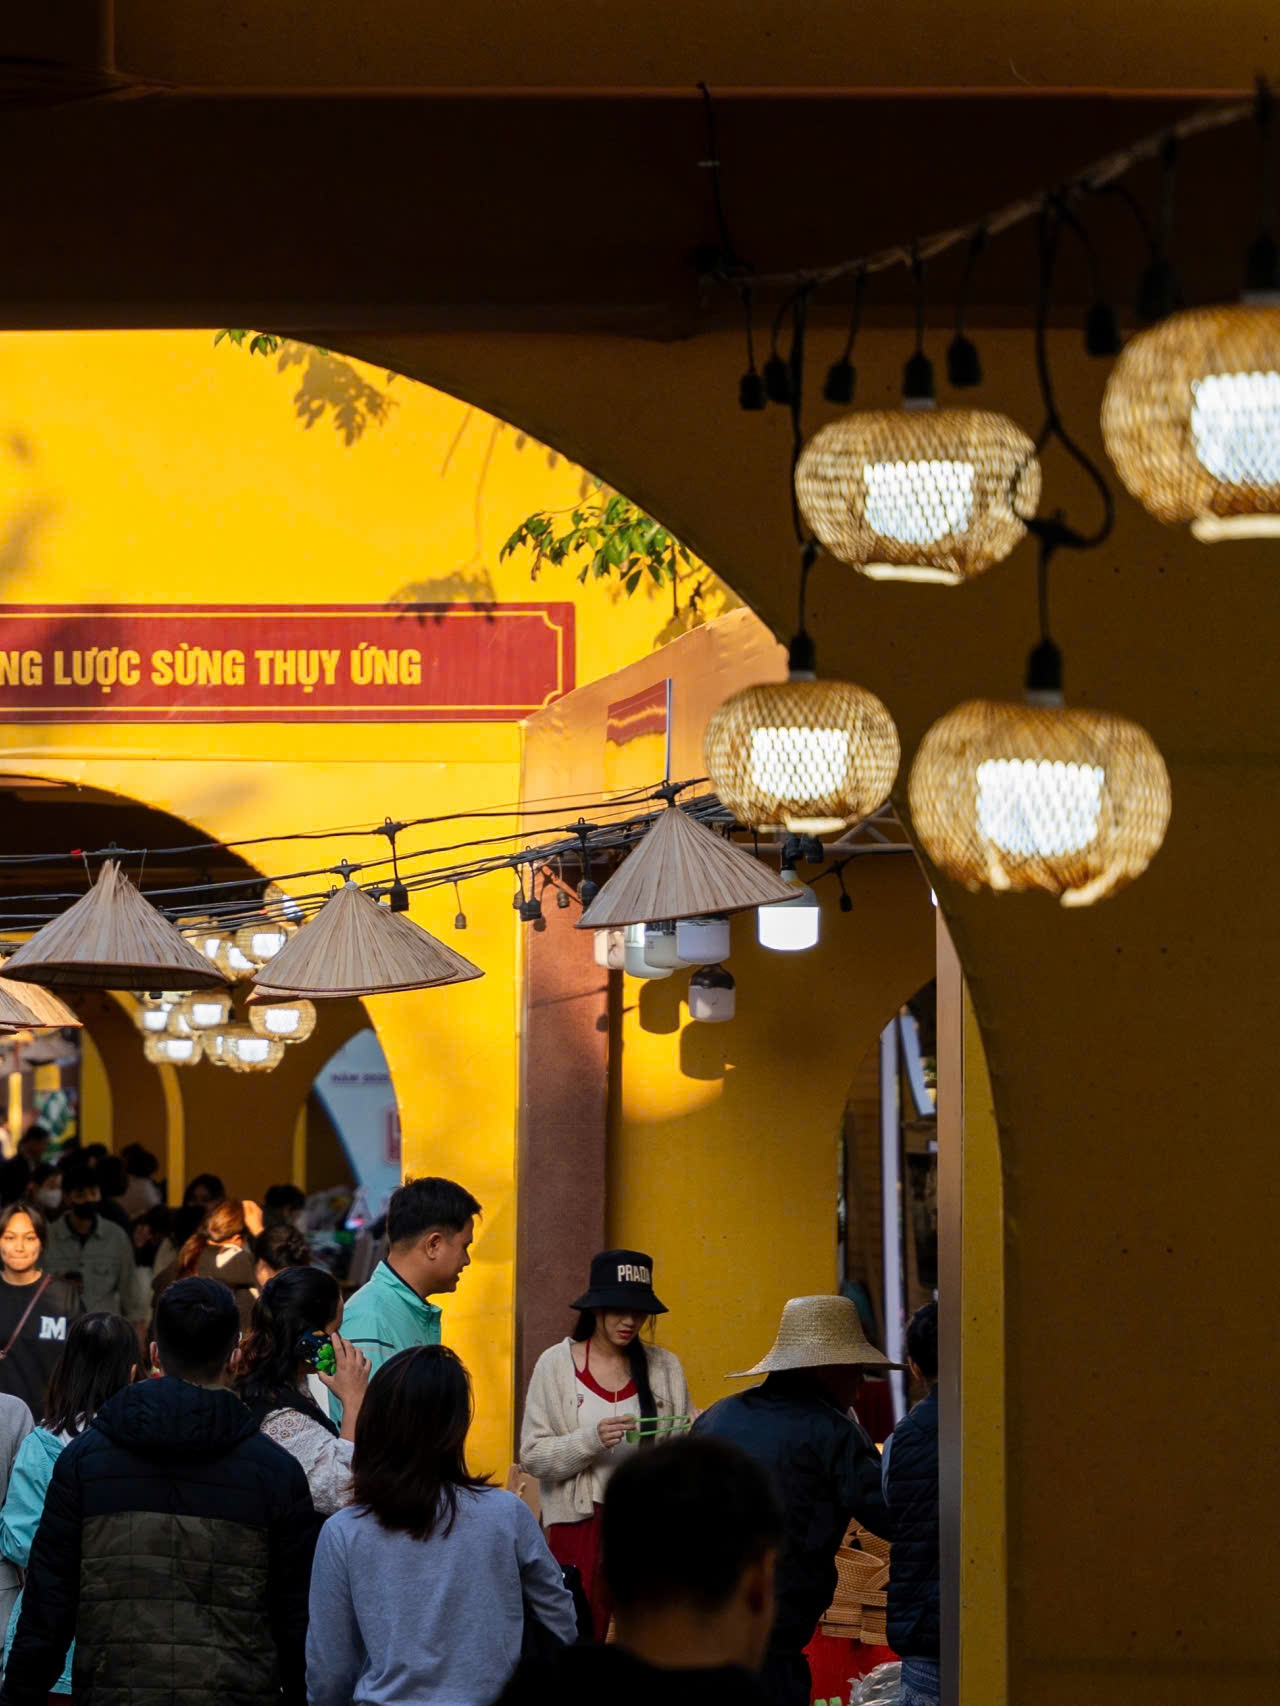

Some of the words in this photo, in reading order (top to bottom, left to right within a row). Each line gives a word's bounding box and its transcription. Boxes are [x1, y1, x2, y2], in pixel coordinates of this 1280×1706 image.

[53, 646, 141, 694] LƯỢC
[150, 642, 246, 687] SỪNG
[253, 649, 341, 694] THỤY
[350, 641, 422, 686] ỨNG
